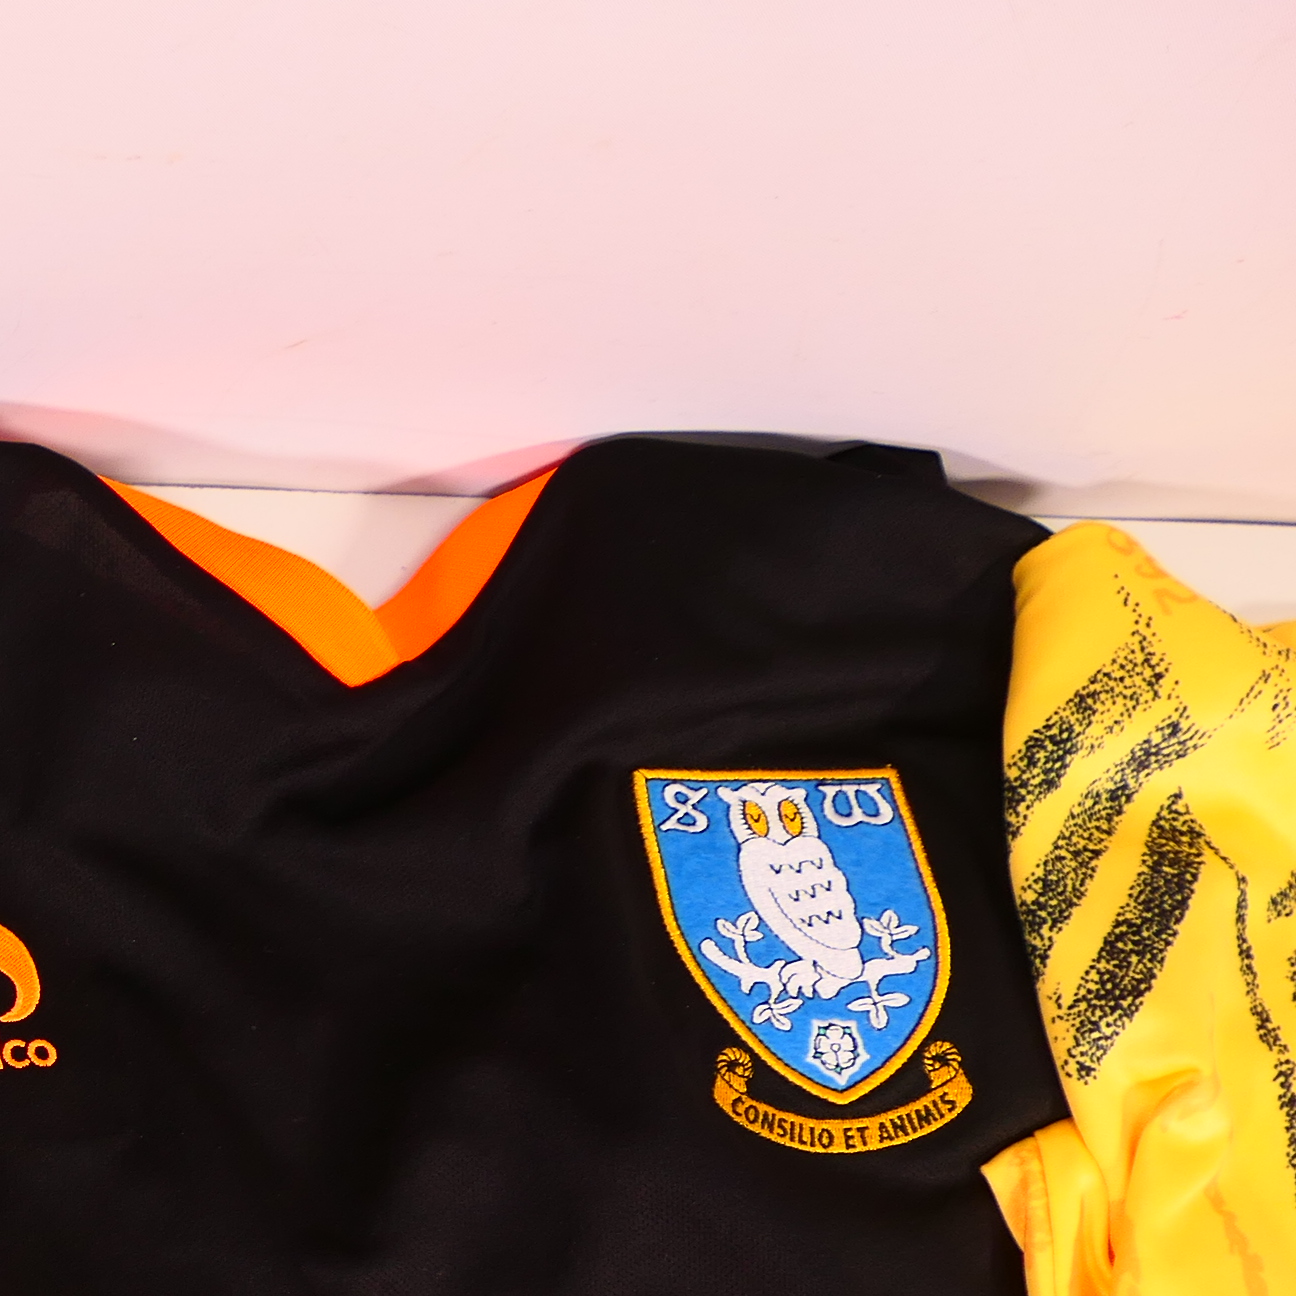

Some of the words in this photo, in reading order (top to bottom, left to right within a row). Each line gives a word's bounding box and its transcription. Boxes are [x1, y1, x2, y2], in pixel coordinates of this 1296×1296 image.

[731, 1096, 835, 1149] CONSILIO
[844, 1126, 870, 1151] ET
[878, 1091, 958, 1144] ANIMIS
